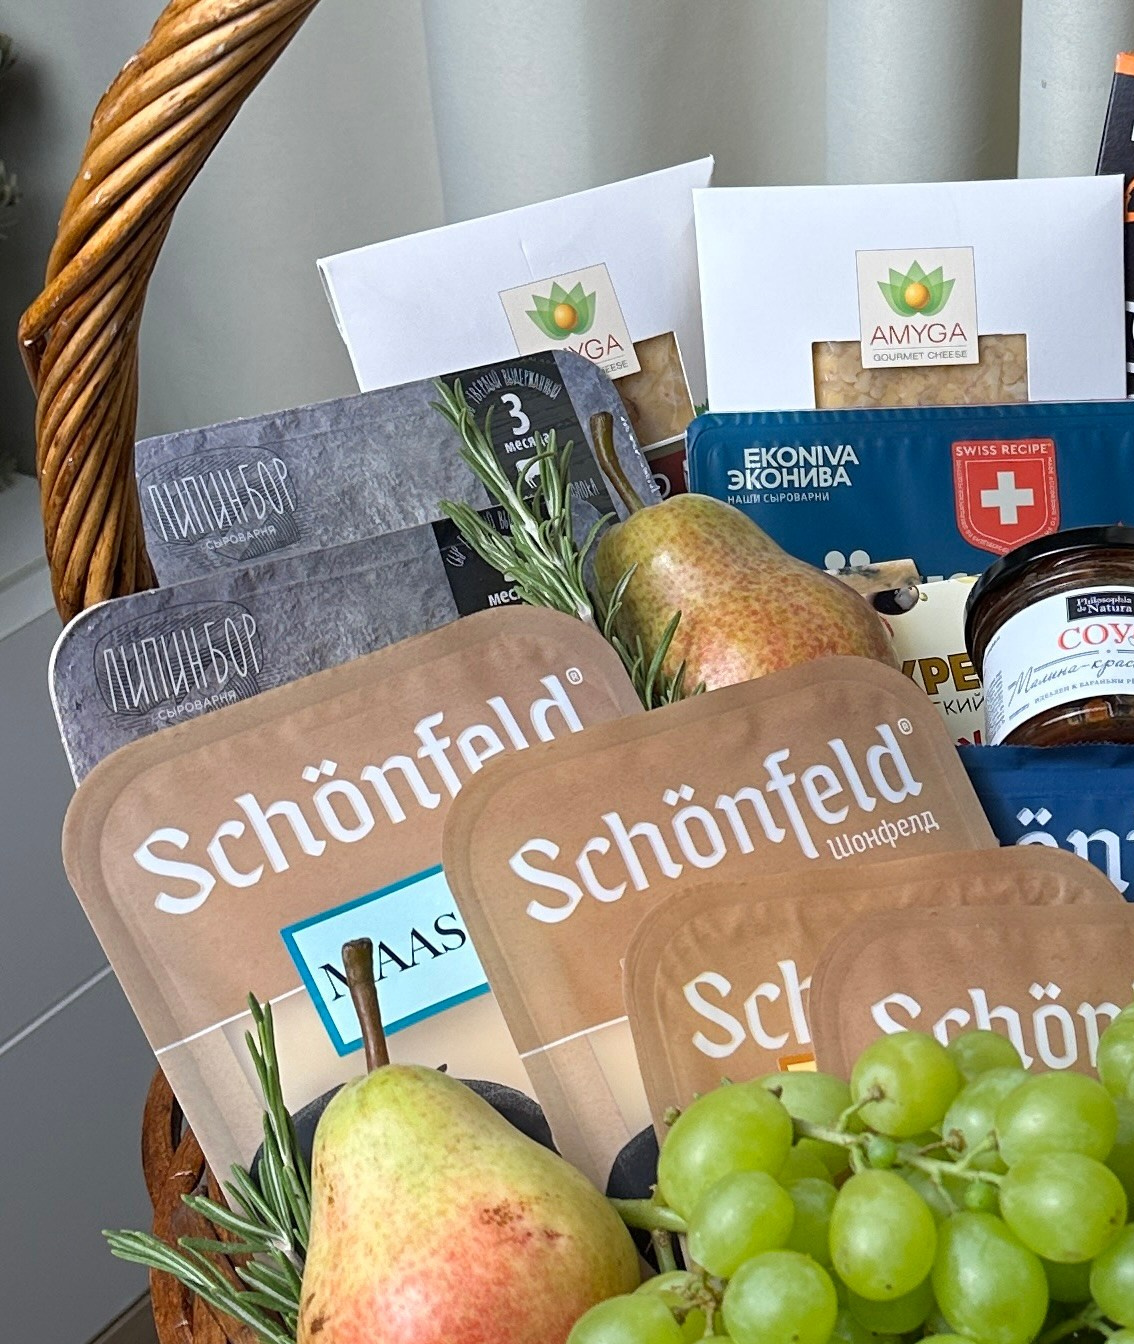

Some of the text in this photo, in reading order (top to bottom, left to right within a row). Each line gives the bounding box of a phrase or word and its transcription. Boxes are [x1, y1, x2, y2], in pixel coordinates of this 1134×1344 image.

[563, 333, 625, 360] YGA
[870, 322, 967, 346] AMYGA
[873, 350, 968, 362] GOURMET CHEESE
[500, 392, 531, 436] 3
[503, 432, 551, 454] месяа
[955, 443, 1048, 457] SWISS RECIPE
[743, 444, 860, 469] EKONIVA
[727, 466, 852, 491] ЭКОНИВА
[727, 491, 830, 505] НАШИ СЫРОВАРНИ
[205, 525, 277, 550] СЫРОВАРНЯ
[1087, 603, 1133, 614] Natura
[157, 689, 237, 720] СЫРОВАРНЯ
[826, 809, 940, 861] Шонфелд
[682, 959, 812, 1059] Sch
[870, 982, 1124, 1070] Schön
